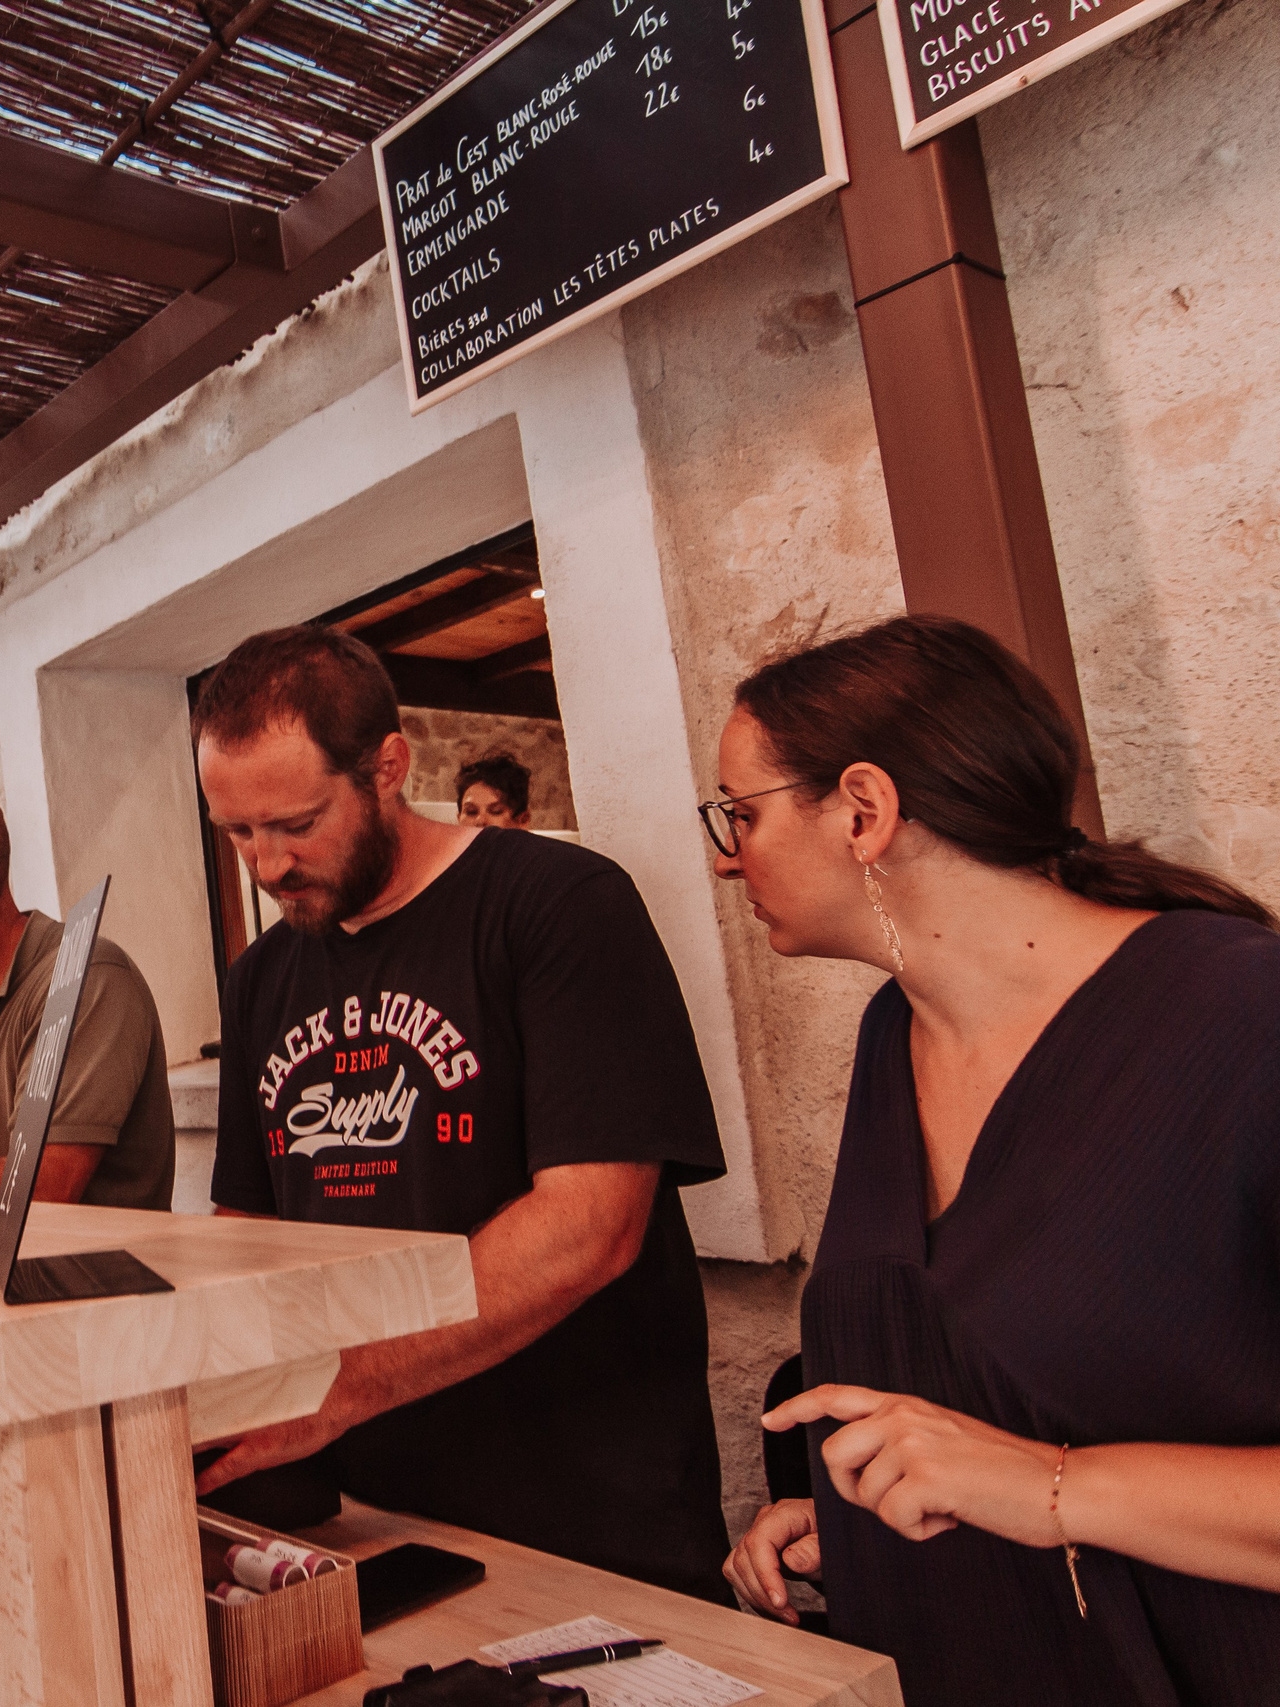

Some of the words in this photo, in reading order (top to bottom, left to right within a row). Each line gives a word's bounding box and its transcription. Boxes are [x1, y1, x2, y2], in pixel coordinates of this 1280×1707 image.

[630, 5, 670, 40] 15€
[920, 0, 1006, 67] GLACE
[635, 45, 673, 78] 18€
[731, 30, 756, 61] 5€
[927, 12, 1052, 103] BISCUITS
[644, 81, 680, 118] 22€
[743, 84, 767, 112] 6€
[749, 138, 775, 163] 4€
[396, 171, 430, 214] PRAT
[436, 163, 453, 188] de
[457, 135, 489, 174] CEST
[402, 188, 457, 245] MARGOT
[407, 190, 510, 277] ERMENGARDE
[412, 248, 501, 320] COCKTAILS
[421, 298, 543, 385] COLLABORATION
[553, 276, 581, 306] LES
[583, 239, 640, 284] TÊTES
[648, 197, 719, 251] PLATES
[259, 1007, 335, 1110] JACK
[344, 996, 362, 1039] &
[370, 991, 480, 1090] JONES
[335, 1043, 389, 1073] DENIM
[287, 1064, 418, 1158] Supply
[268, 1128, 285, 1157] 19
[437, 1112, 473, 1143] 90
[314, 1164, 350, 1180] LIMITED
[354, 1160, 398, 1177] EDITION
[324, 1183, 376, 1198] TRADEMARK
